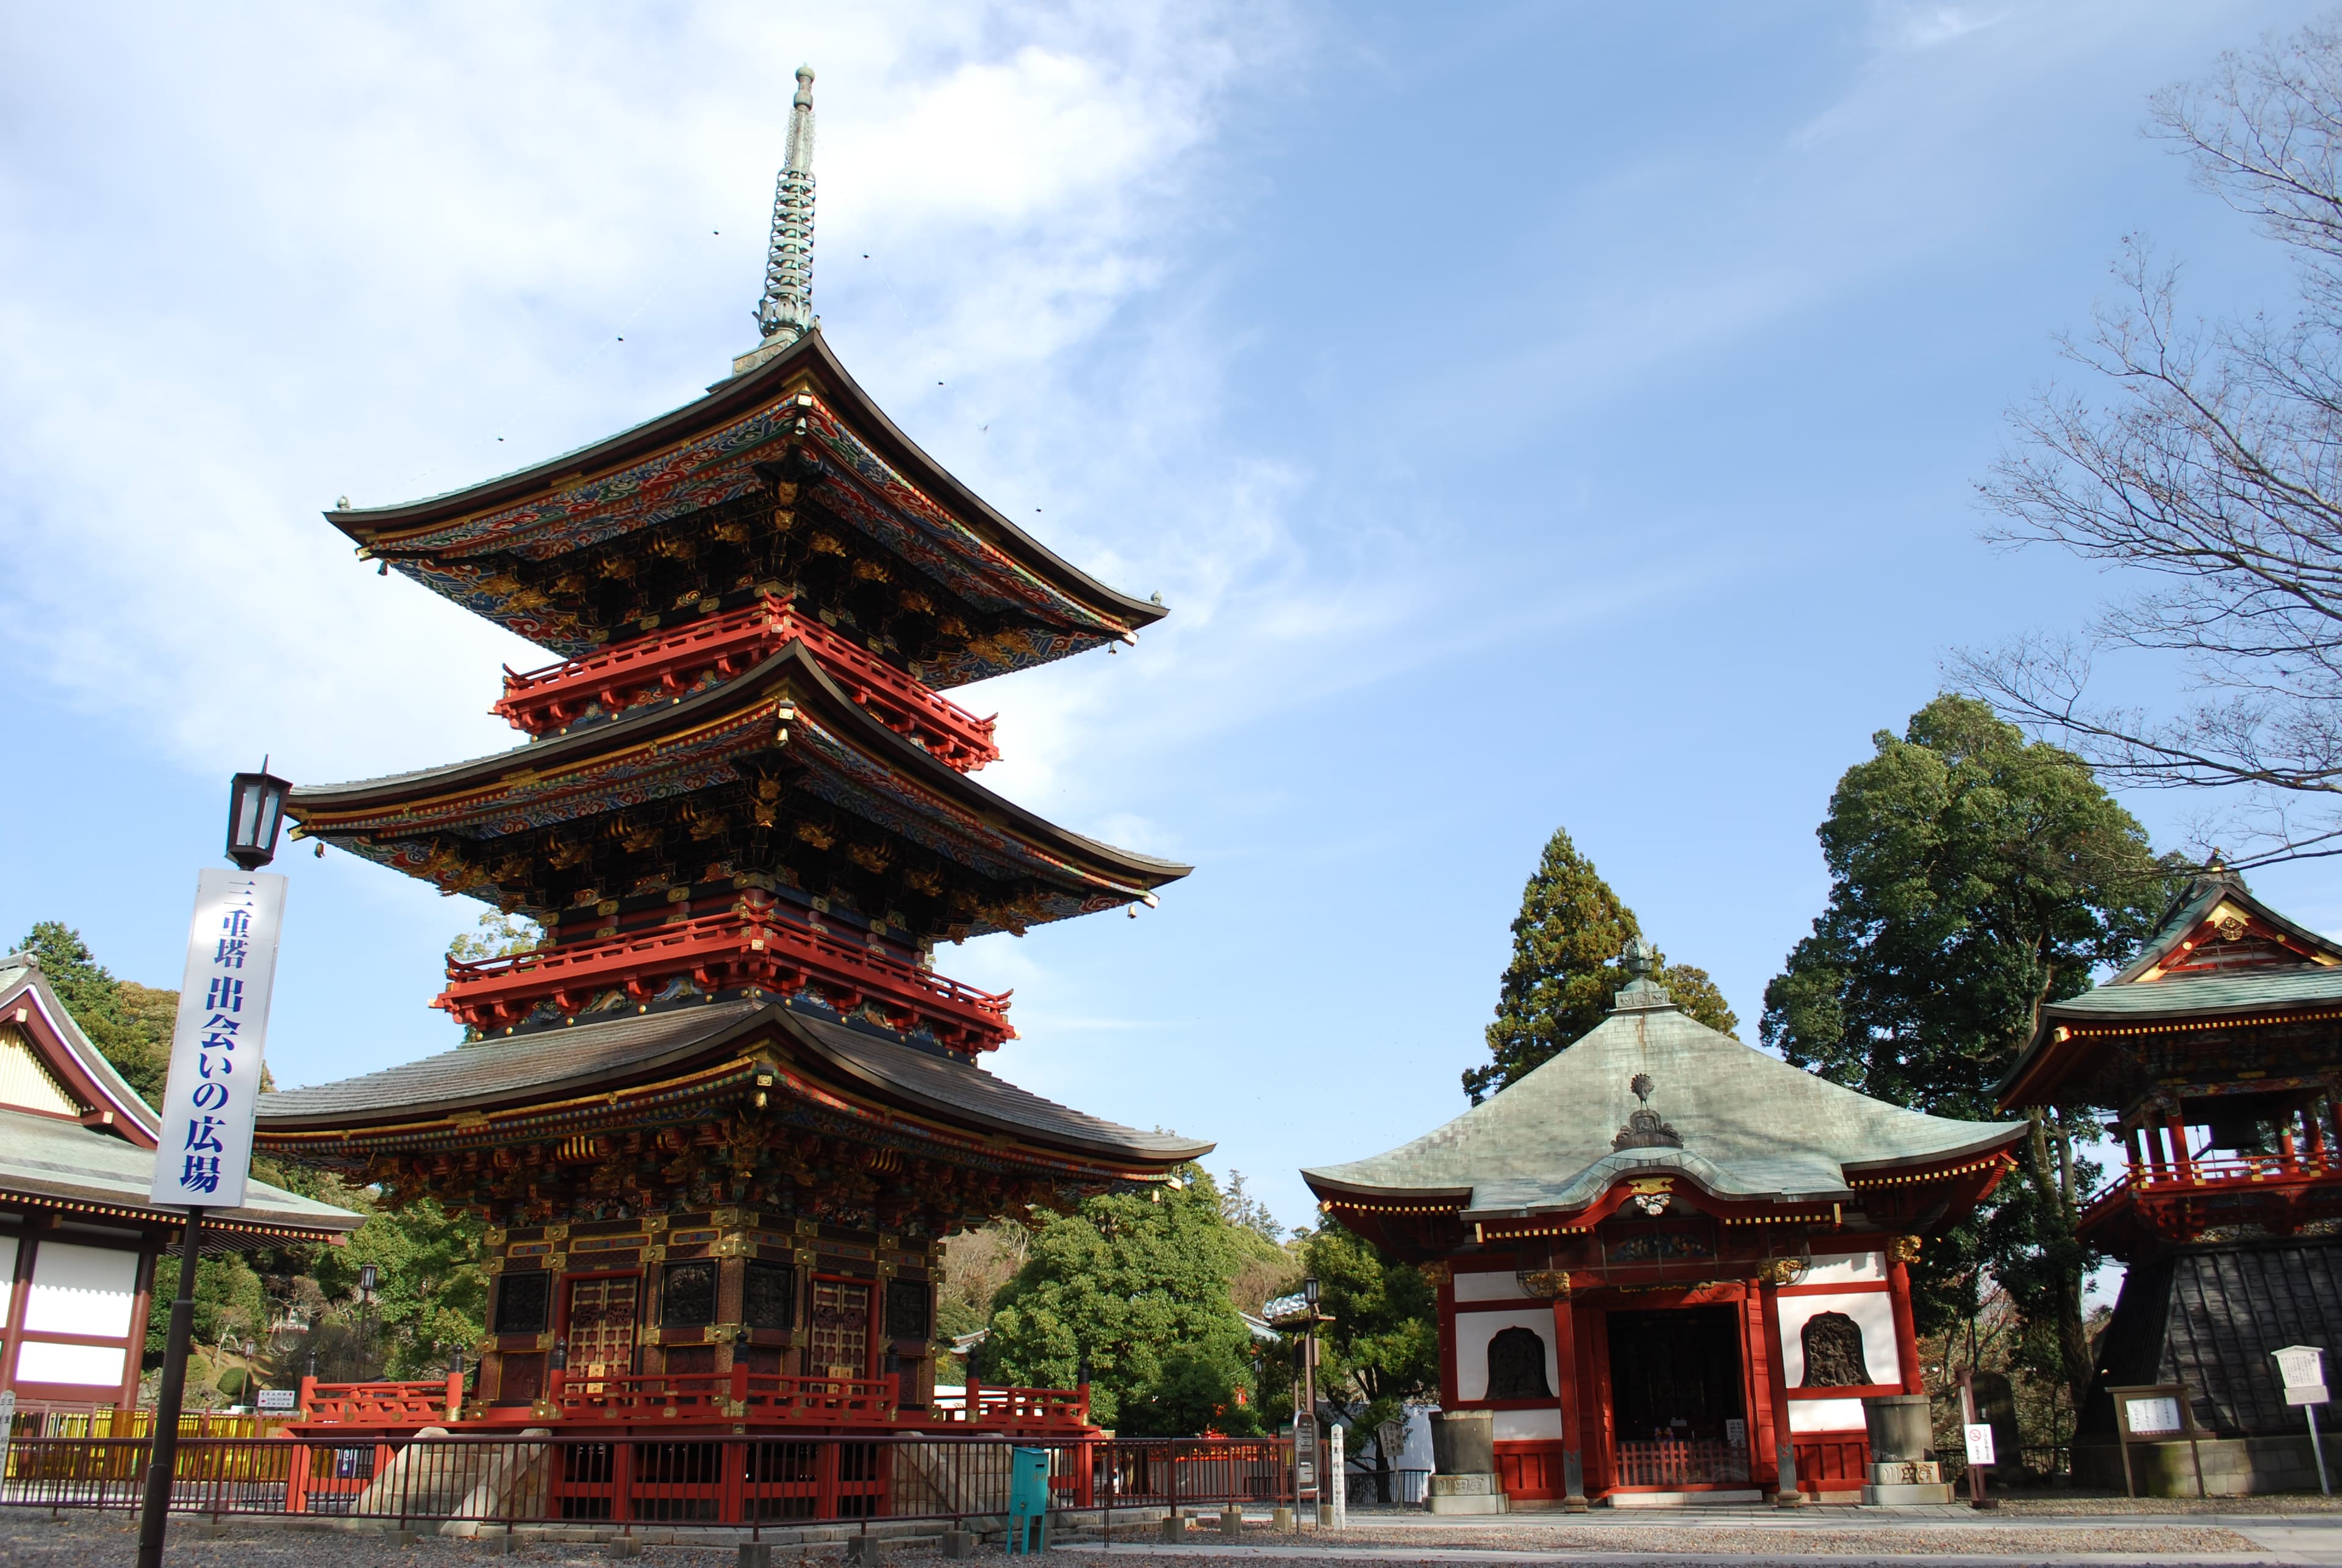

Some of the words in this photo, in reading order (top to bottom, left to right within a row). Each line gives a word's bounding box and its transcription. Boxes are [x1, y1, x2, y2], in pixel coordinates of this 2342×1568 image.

[214, 880, 256, 968] 三重塔
[179, 976, 244, 1193] 出会いの広場
